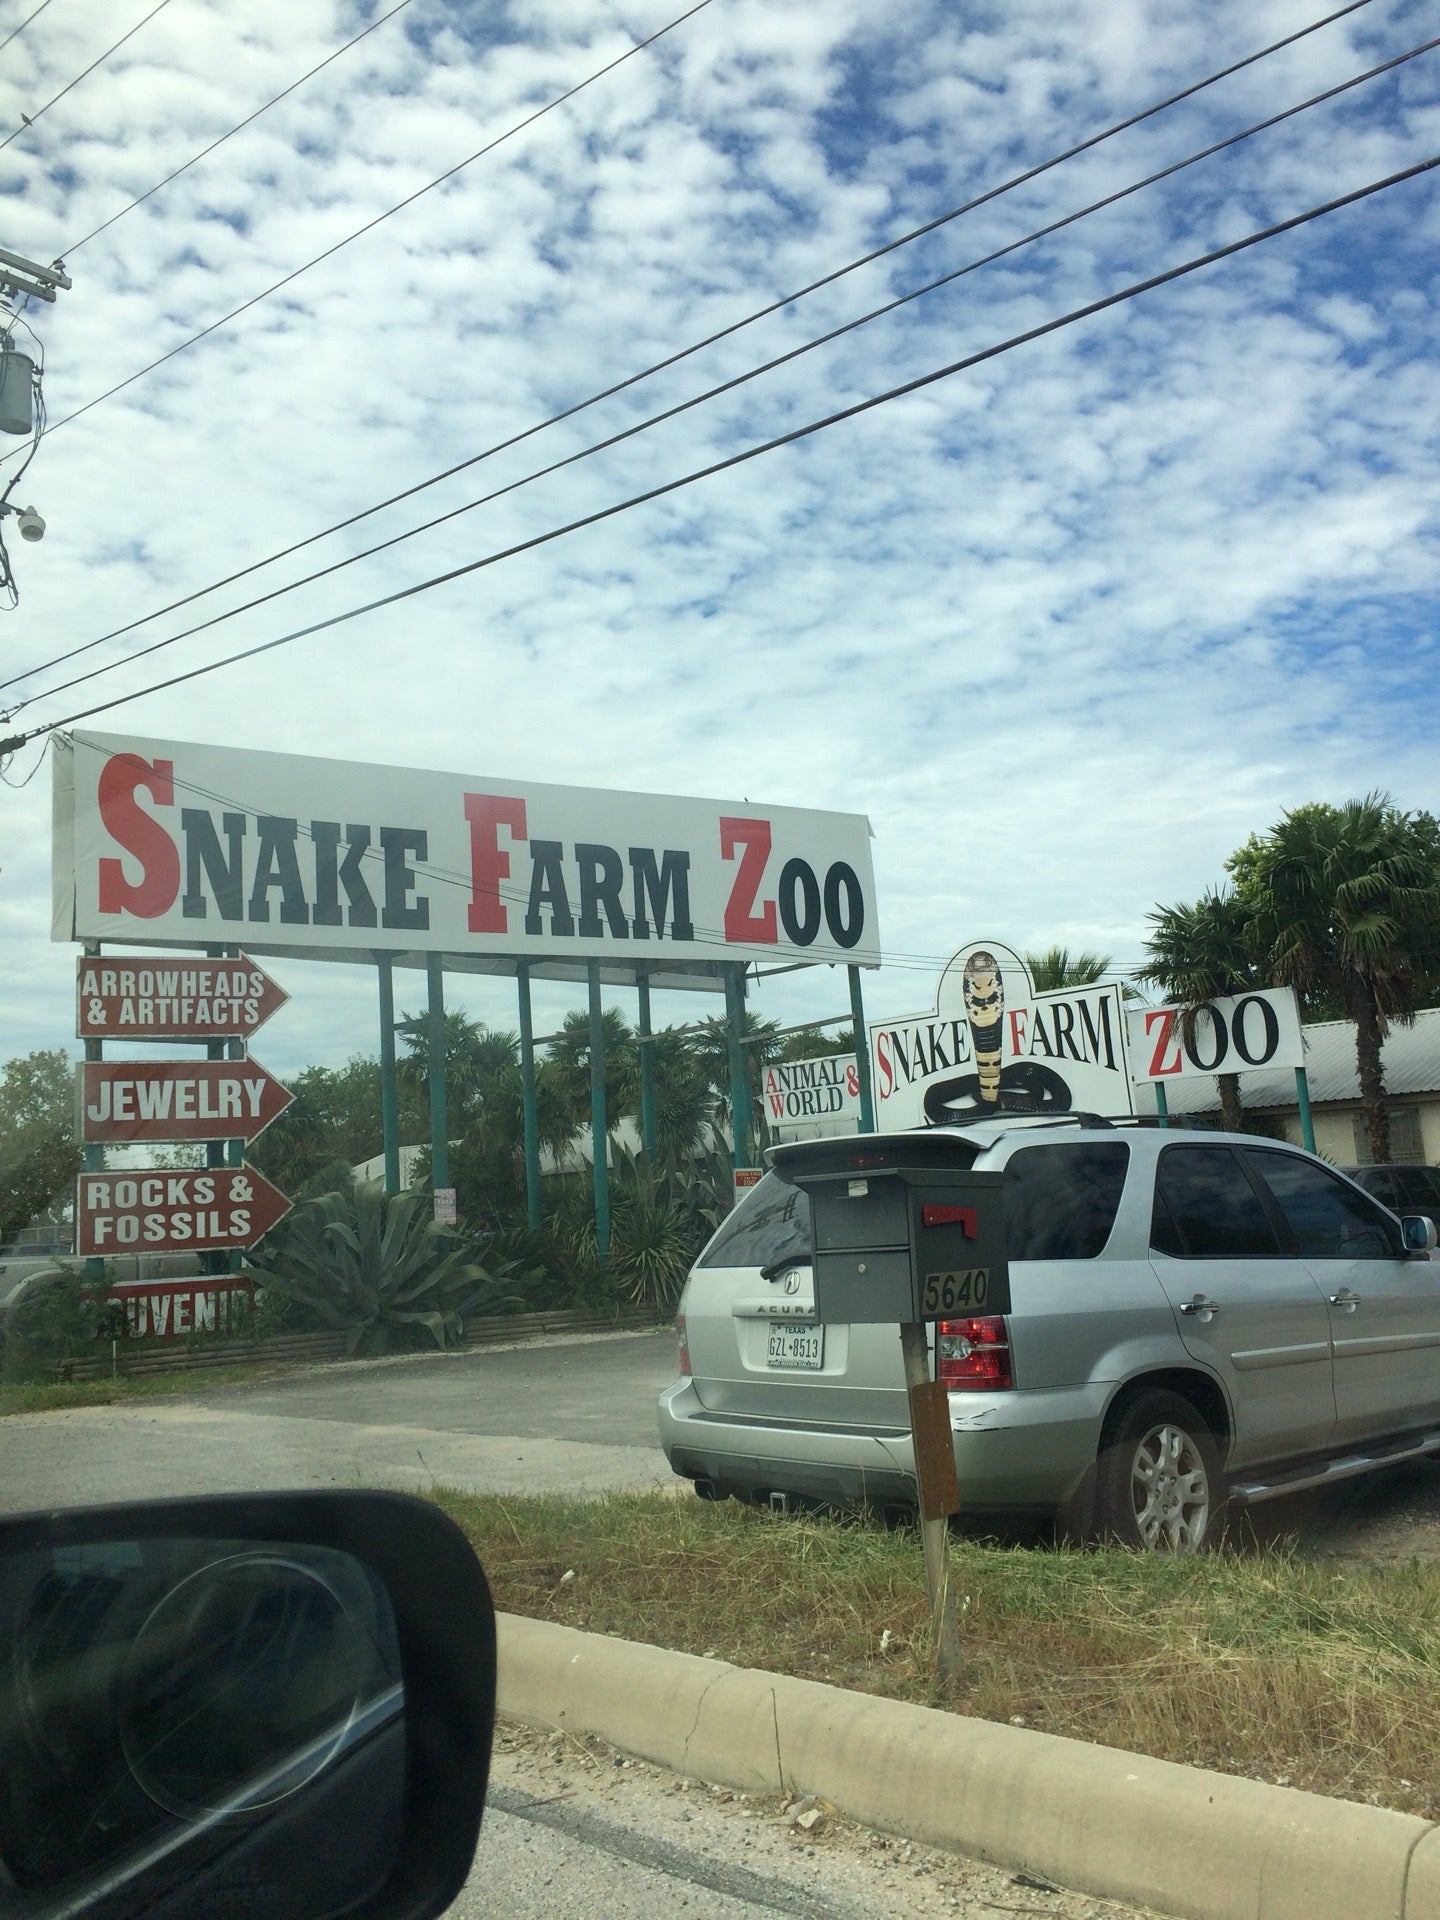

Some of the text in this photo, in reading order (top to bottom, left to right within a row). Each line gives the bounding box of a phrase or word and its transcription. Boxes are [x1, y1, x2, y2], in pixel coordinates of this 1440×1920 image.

[98, 753, 865, 949] SNAKE FARM ZOO
[81, 970, 265, 998] ARROWHEADS
[87, 998, 260, 1025] & ARTIFACTS
[877, 995, 1120, 1102] SNAKE FARM
[1145, 995, 1280, 1077] ZOO
[765, 1059, 860, 1097] ANIMAL &
[87, 1078, 267, 1122] JEWELRY
[769, 1086, 843, 1119] WORLD
[87, 1175, 254, 1210] ROCKS &
[94, 1209, 251, 1245] FOSSILS
[757, 1305, 816, 1314] ACURA
[925, 1270, 987, 1312] 5640
[79, 1288, 266, 1339] UVENI
[785, 1326, 806, 1335] TEXAS
